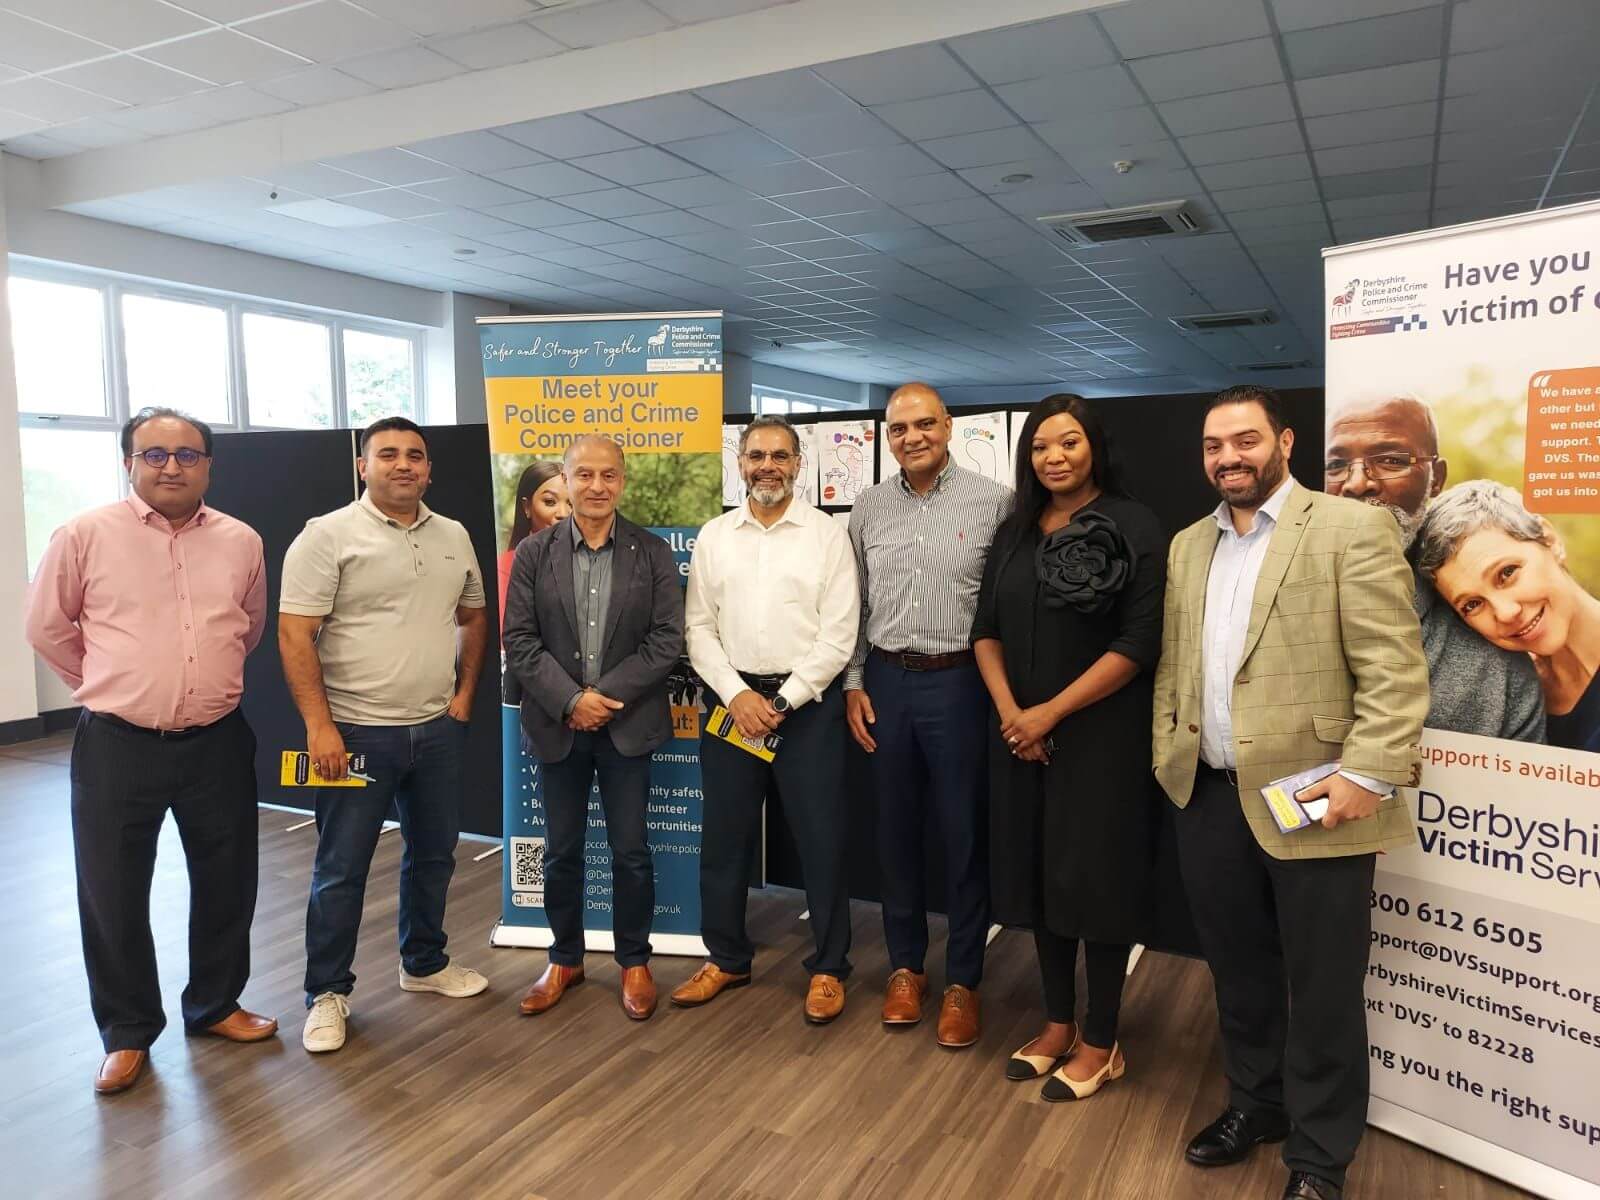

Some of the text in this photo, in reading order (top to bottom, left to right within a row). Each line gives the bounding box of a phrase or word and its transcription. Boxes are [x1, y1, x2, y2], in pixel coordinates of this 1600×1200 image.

[1445, 251, 1590, 289] Have you
[1363, 275, 1406, 288] Derbyshire
[1362, 282, 1428, 297] Police and Crime
[1361, 293, 1418, 307] Commissioner
[1442, 295, 1538, 326] victim
[1549, 285, 1586, 314] of
[671, 325, 704, 334] Derbyshire
[483, 343, 514, 362] Safer
[517, 336, 542, 356] and
[542, 342, 590, 369] Stronger
[593, 334, 643, 368] Together
[671, 340, 714, 348] Commissioner
[542, 378, 659, 403] Meet your
[1540, 388, 1559, 398] We
[1561, 386, 1592, 397] have
[505, 402, 699, 424] Police and Crime
[1540, 402, 1595, 414] other but
[1551, 421, 1567, 430] we
[519, 427, 684, 449] Comsioner
[1541, 437, 1592, 448] support.
[1545, 453, 1572, 464] DVS.
[1528, 472, 1557, 482] gave
[1560, 471, 1575, 479] us
[1533, 487, 1598, 498] got us into
[651, 753, 701, 764] commun
[1418, 744, 1600, 788] upport is availab
[671, 786, 704, 801] safety
[1417, 790, 1599, 858] Derbyshi
[1416, 826, 1524, 875] Victim
[585, 856, 609, 865] 0300
[586, 885, 613, 896] @Der
[1417, 902, 1464, 932] 612
[1473, 918, 1544, 954] 6505
[1367, 963, 1600, 1049] rbyshireVictimServices
[1443, 1021, 1463, 1039] to
[1468, 1029, 1535, 1064] 82228
[1401, 1055, 1440, 1081] you
[1446, 1070, 1485, 1098] the
[1491, 1087, 1552, 1124] right
[1558, 1113, 1600, 1146] sup
